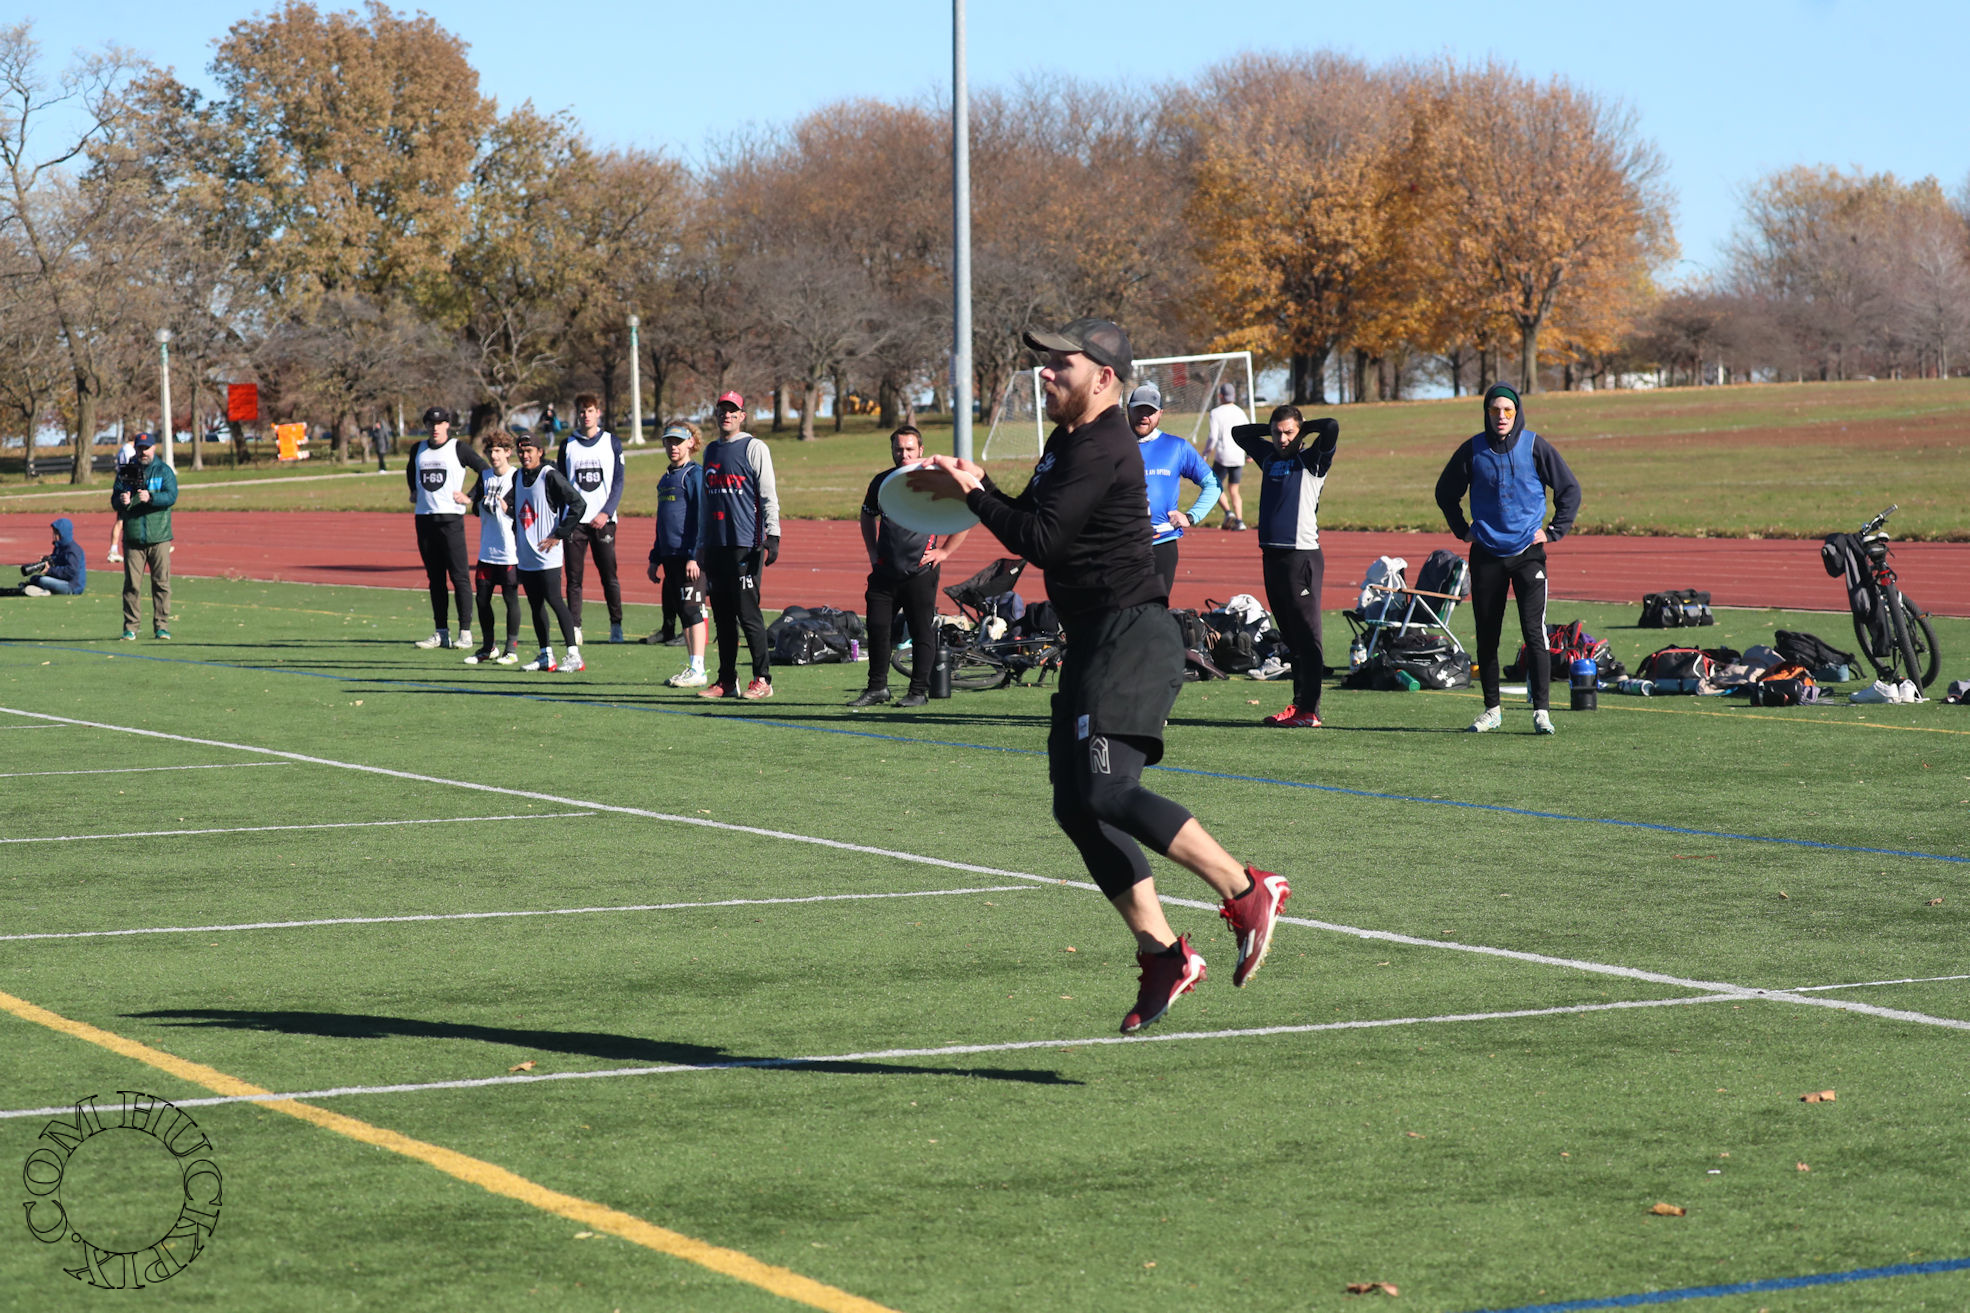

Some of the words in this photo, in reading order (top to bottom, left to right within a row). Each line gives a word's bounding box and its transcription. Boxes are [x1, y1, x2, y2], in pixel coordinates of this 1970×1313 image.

[423, 472, 444, 483] I-69
[578, 471, 601, 483] I-69
[739, 575, 754, 590] 79
[680, 586, 694, 601] 17
